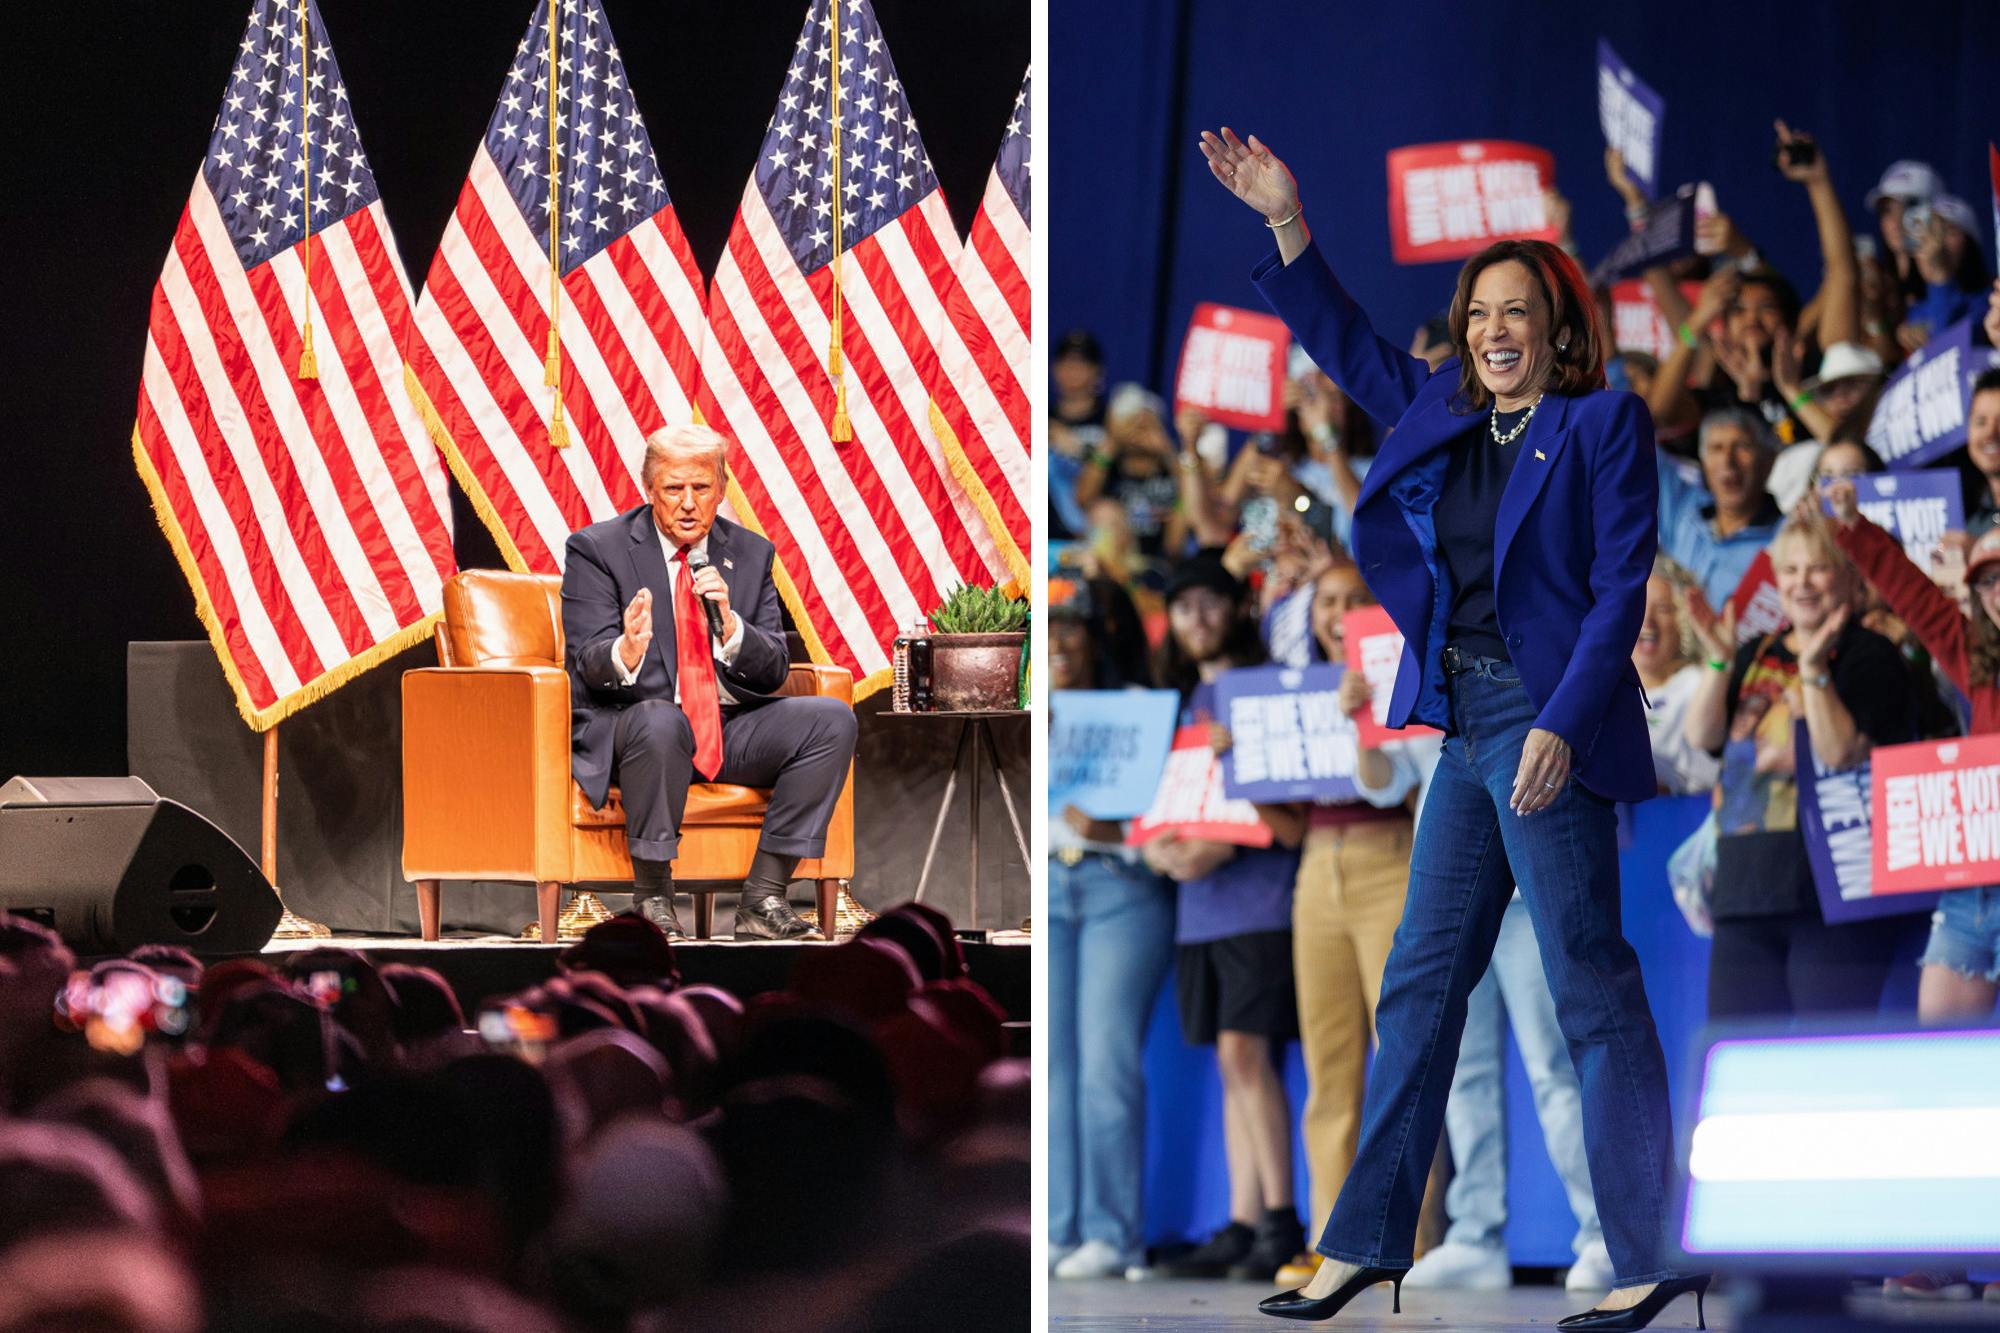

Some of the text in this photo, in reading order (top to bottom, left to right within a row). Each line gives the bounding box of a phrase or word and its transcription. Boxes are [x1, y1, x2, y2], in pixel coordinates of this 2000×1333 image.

[1895, 497, 1947, 545] VOTE
[1918, 770, 1957, 818] WE
[1920, 816, 1964, 867] WE
